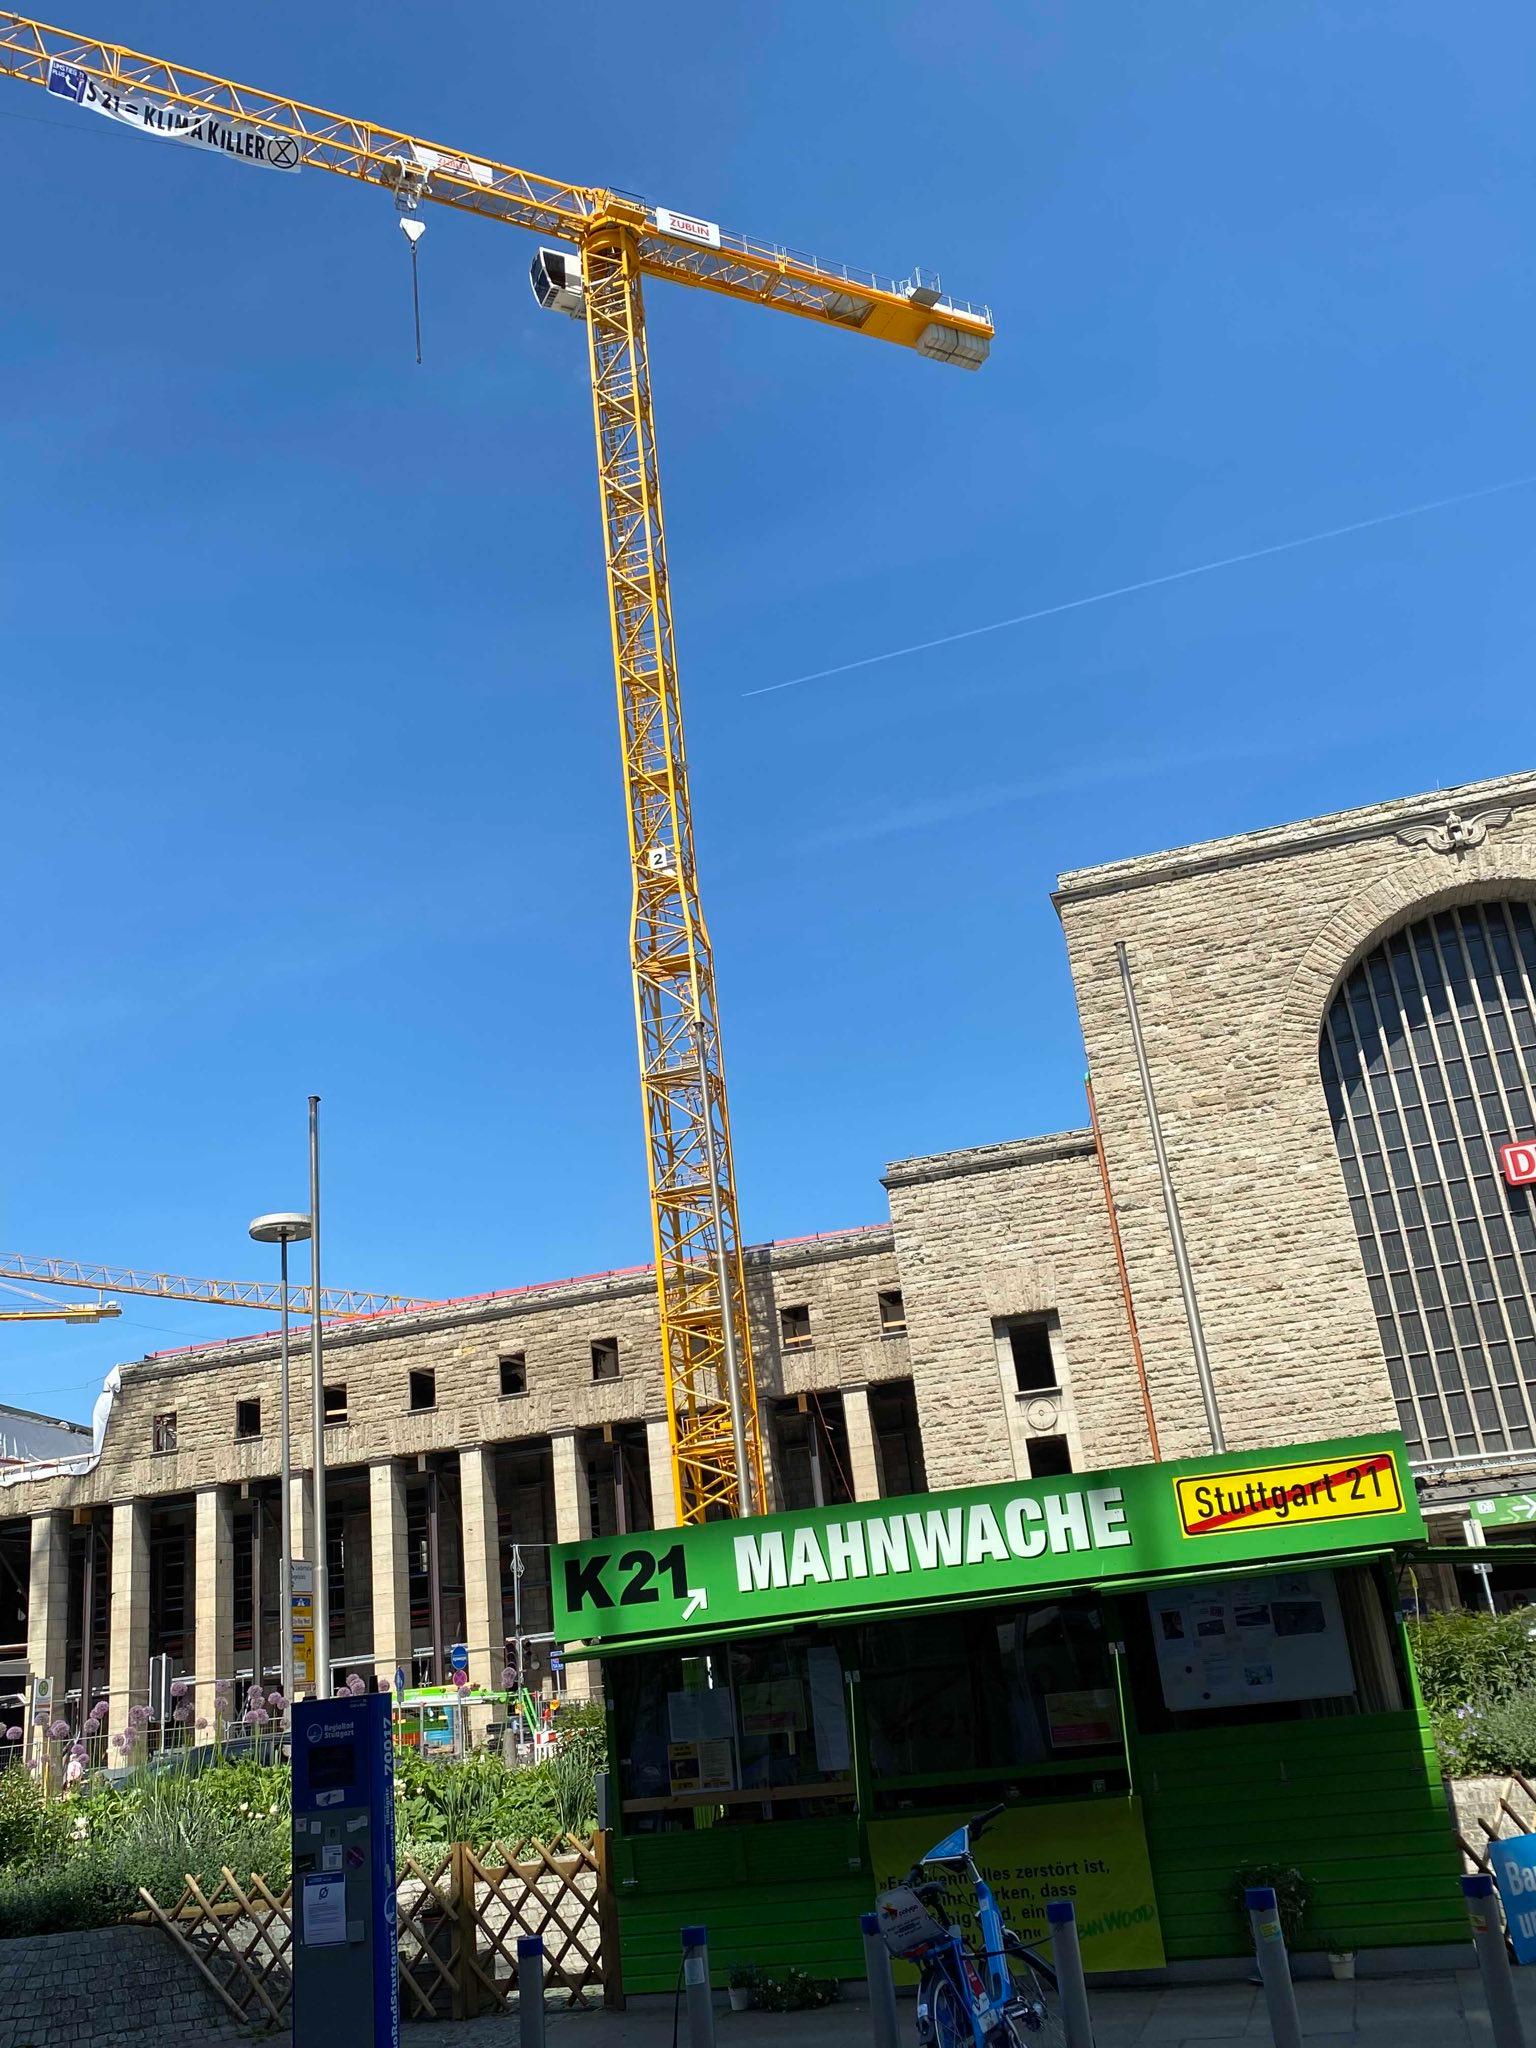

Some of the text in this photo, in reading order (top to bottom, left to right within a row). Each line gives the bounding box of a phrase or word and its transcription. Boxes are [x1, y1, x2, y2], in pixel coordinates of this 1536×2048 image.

[87, 81, 98, 102] S
[101, 90, 120, 113] 21
[144, 105, 202, 141] KLIMA
[207, 119, 265, 160] KILLER
[653, 853, 664, 865] 2
[1509, 1149, 1536, 1177] D
[1194, 1464, 1385, 1519] Stuttgart 21
[564, 1486, 1132, 1613] K21 MAHNWACHE
[384, 1717, 393, 1776] 70017
[1016, 1862, 1080, 1879] zerstört
[1083, 1859, 1110, 1874] ist,
[969, 1886, 1035, 1903] mrken,
[1040, 1883, 1077, 1897] dass
